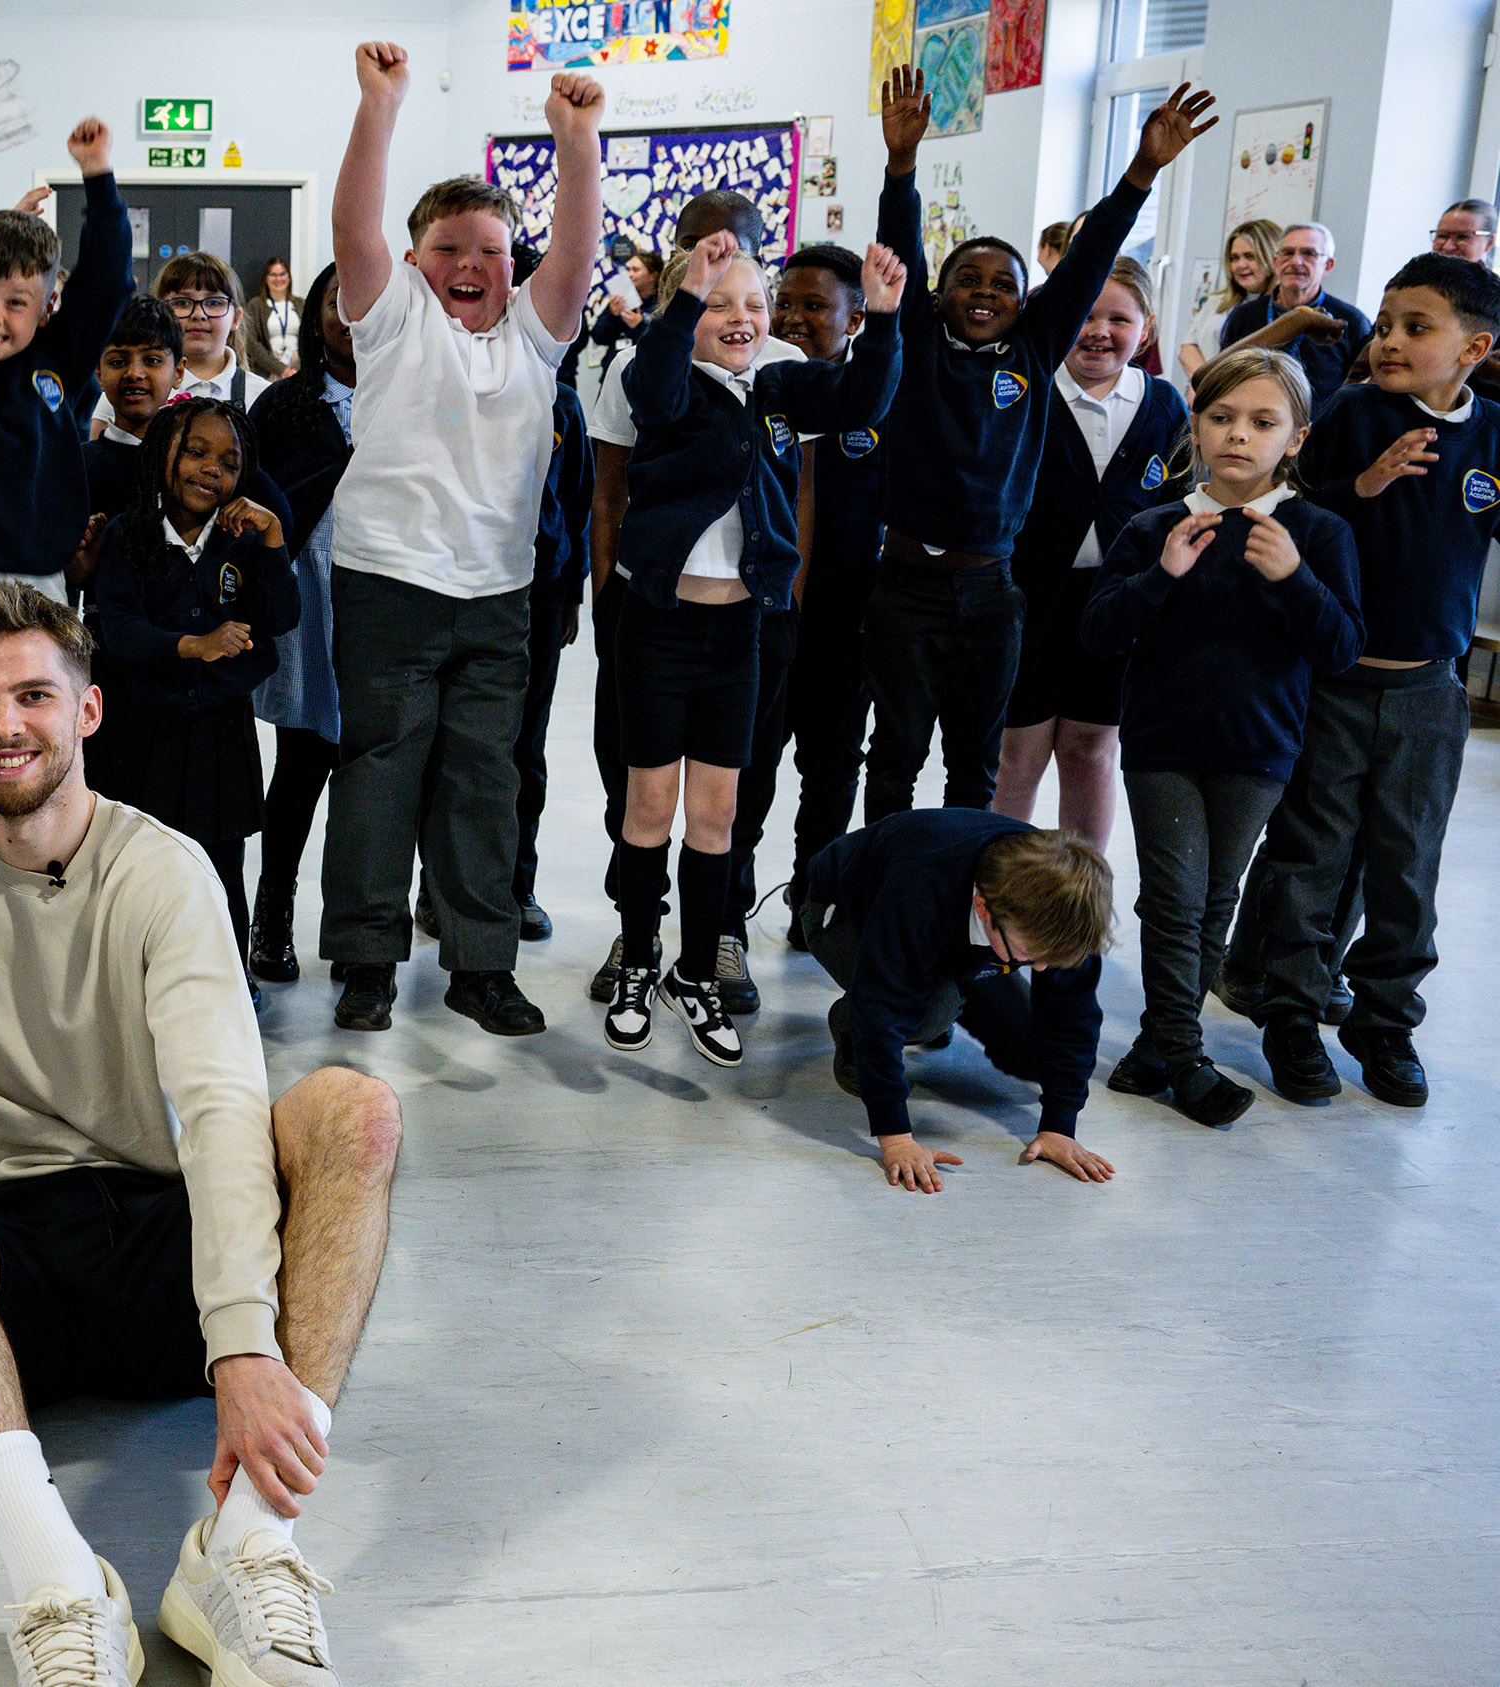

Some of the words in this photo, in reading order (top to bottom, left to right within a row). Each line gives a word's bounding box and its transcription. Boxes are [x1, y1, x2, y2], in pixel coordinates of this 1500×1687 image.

[1470, 477, 1491, 489] Temple
[1469, 490, 1497, 503] Academy
[1470, 484, 1496, 497] Learning
